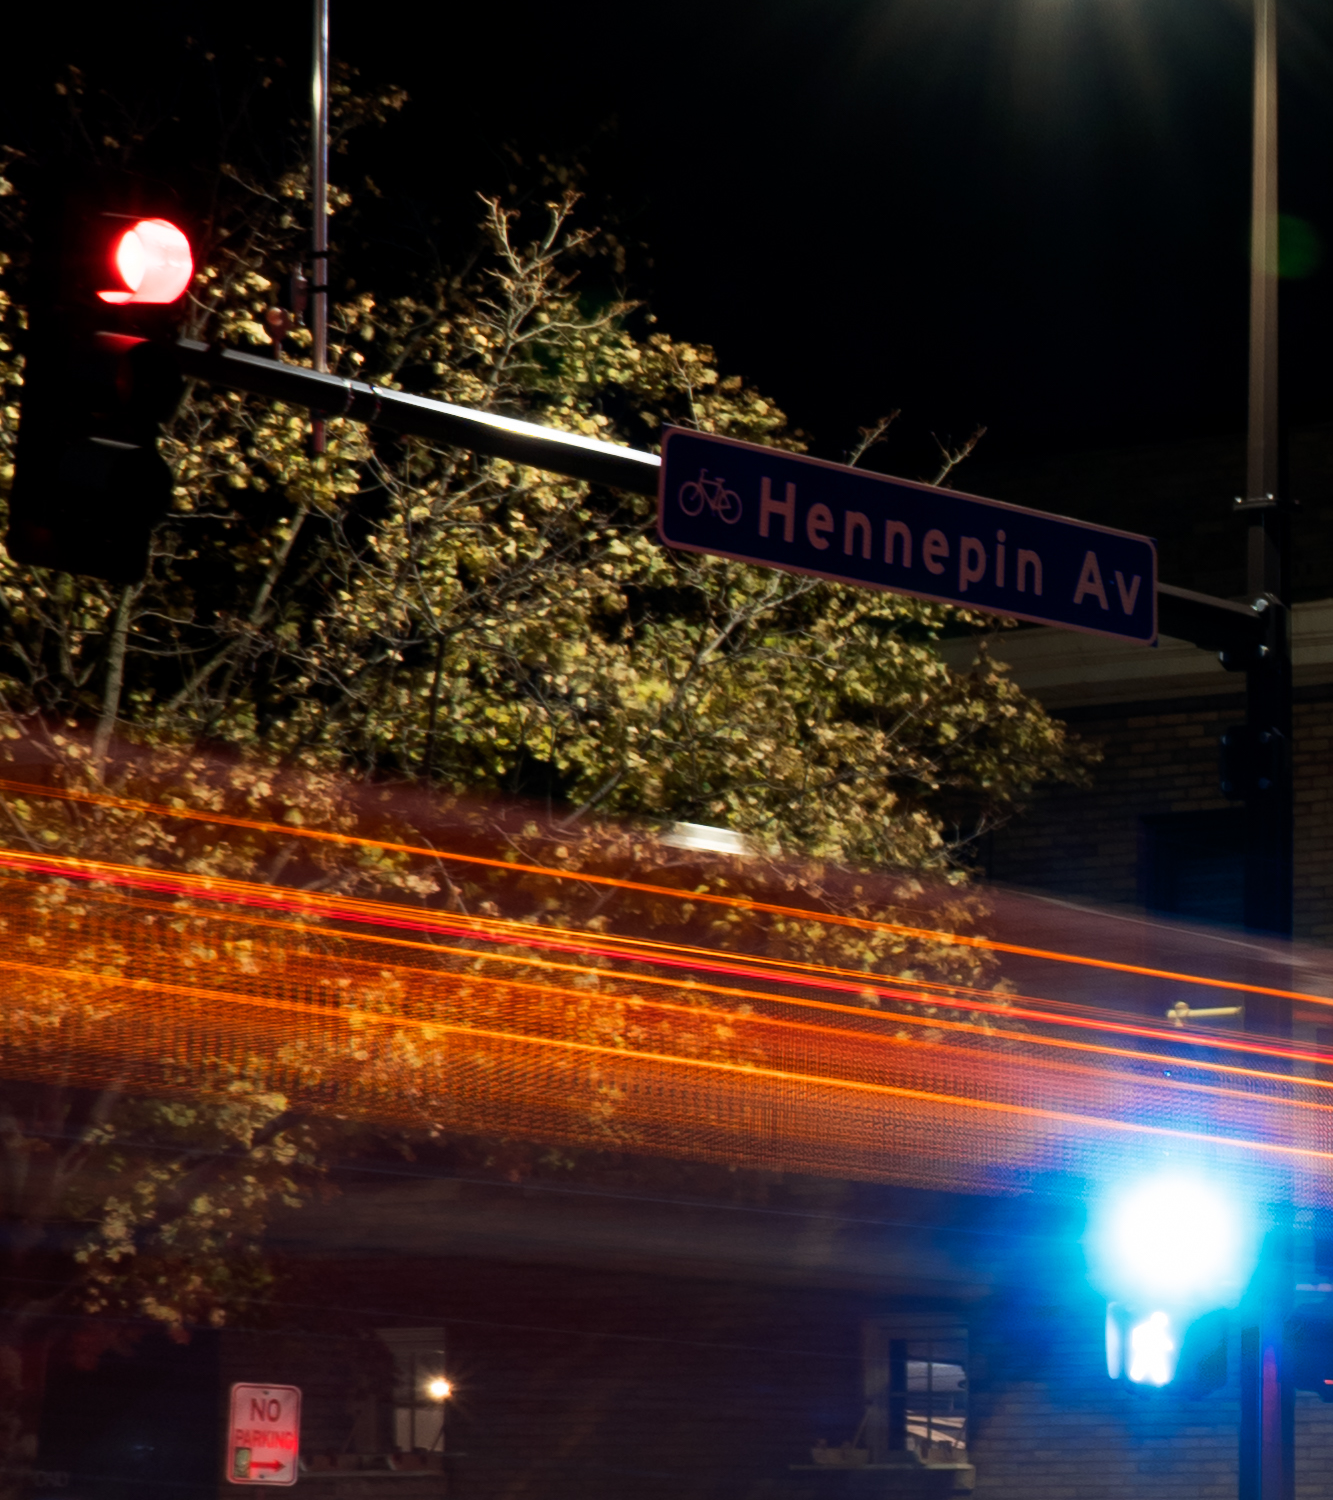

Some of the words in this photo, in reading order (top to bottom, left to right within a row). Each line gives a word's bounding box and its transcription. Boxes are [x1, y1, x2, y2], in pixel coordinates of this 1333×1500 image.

[758, 476, 1043, 596] Hennepin
[1073, 550, 1142, 616] Av
[250, 1398, 281, 1422] NO
[236, 1429, 295, 1450] PARKING
